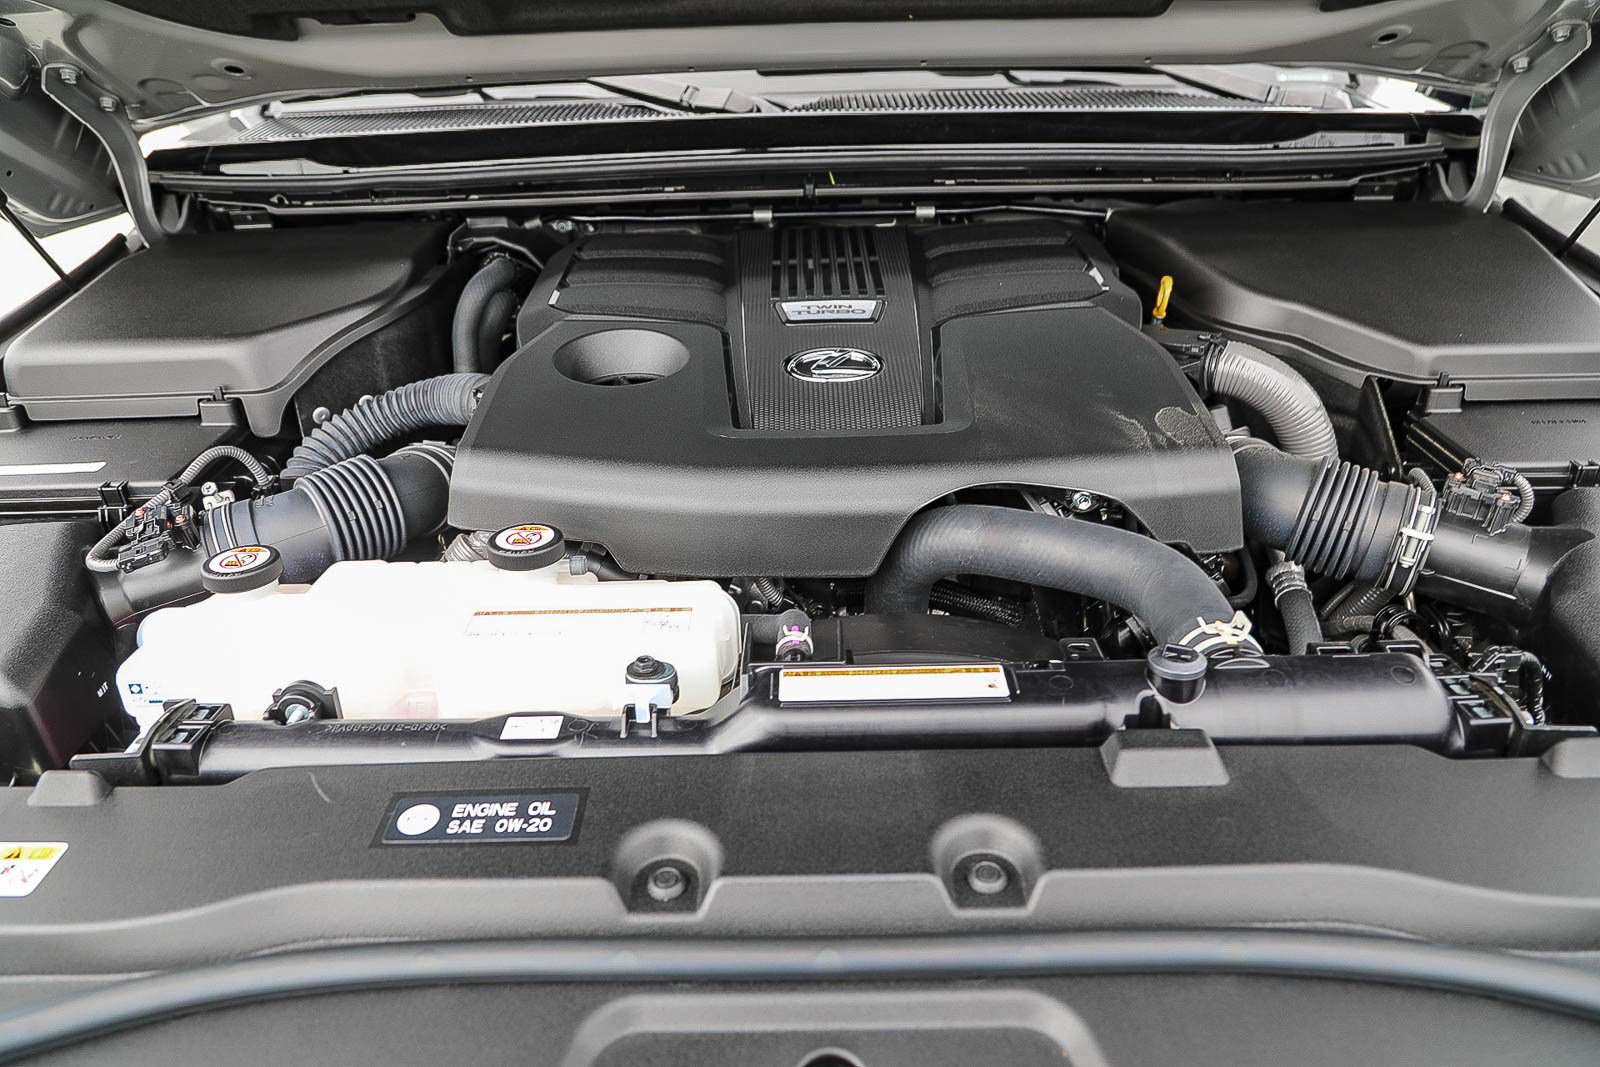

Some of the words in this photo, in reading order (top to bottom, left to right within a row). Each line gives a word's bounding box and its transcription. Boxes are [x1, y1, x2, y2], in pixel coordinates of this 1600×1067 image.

[791, 308, 867, 316] TURBO
[451, 802, 519, 818] ENGINE
[527, 801, 557, 816] OIL
[446, 818, 486, 835] SAE
[494, 817, 553, 833] 0W-20
